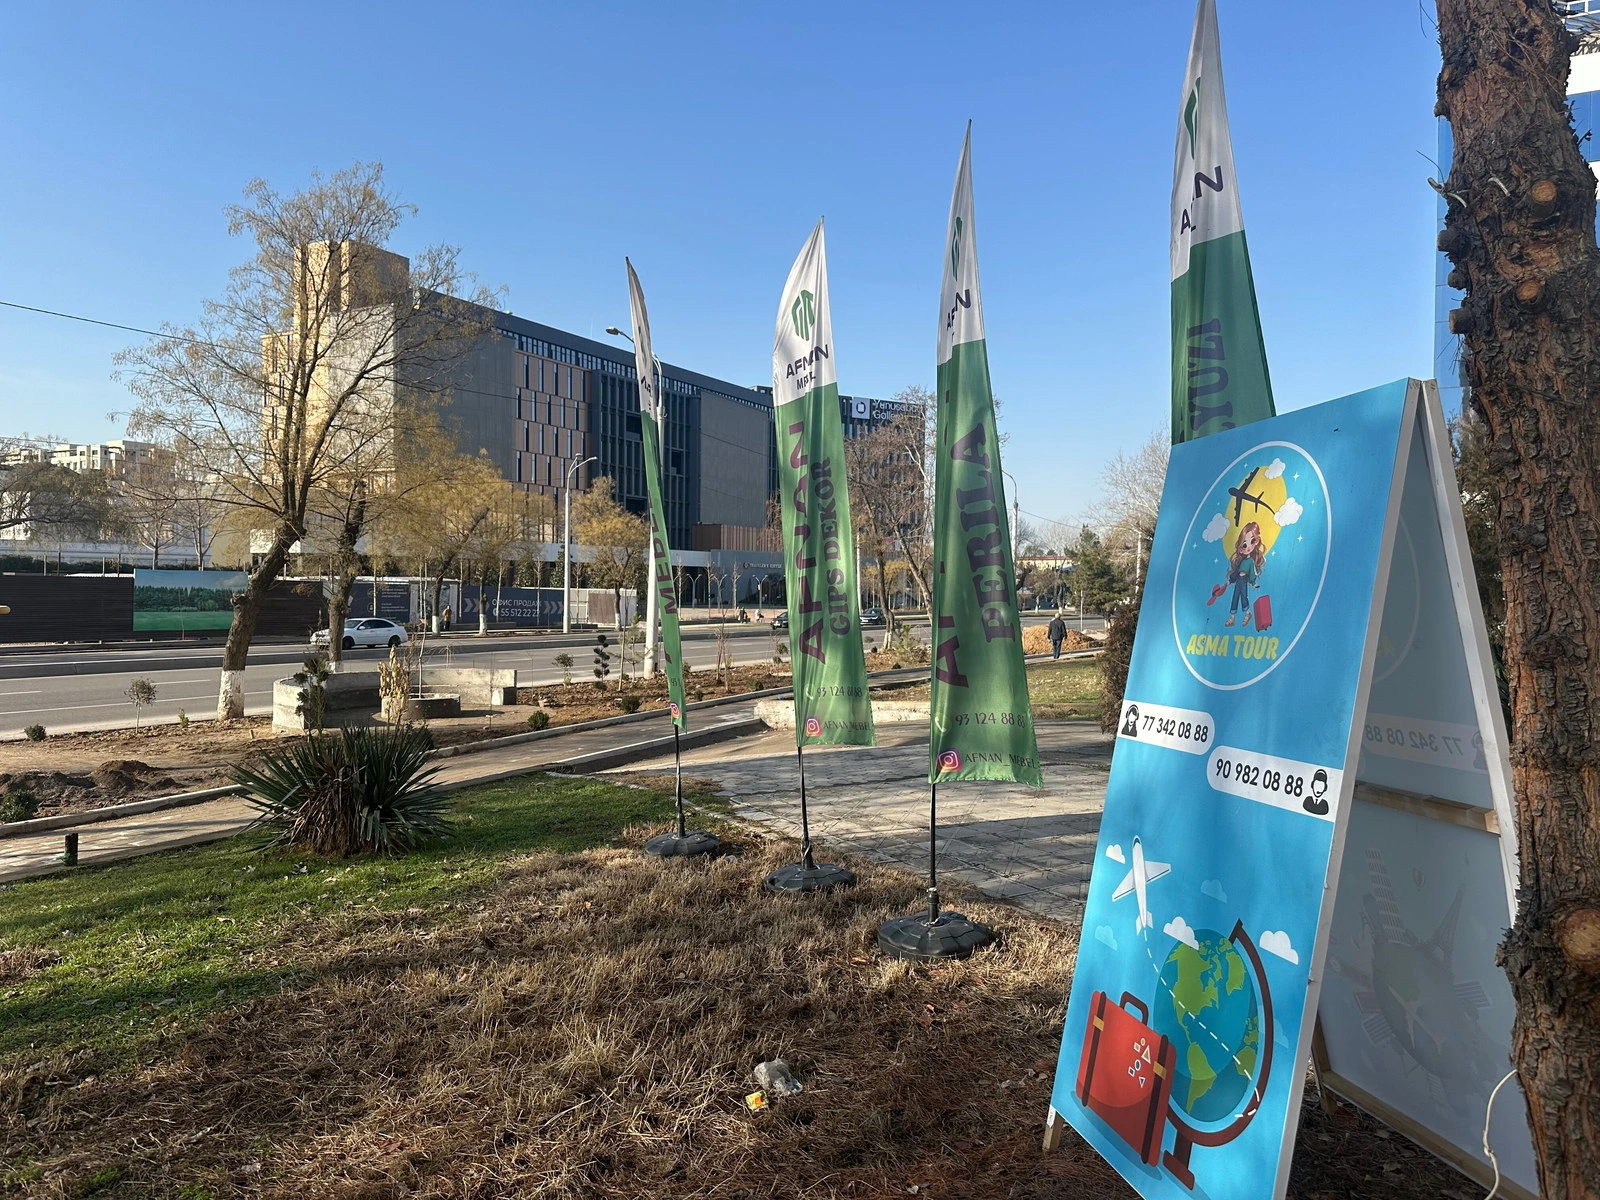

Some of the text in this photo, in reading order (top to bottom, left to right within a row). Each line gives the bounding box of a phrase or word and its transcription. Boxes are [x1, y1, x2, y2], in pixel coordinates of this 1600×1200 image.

[950, 422, 1016, 643] PERILA
[810, 456, 851, 636] GIPS DEKOR
[500, 608, 509, 617] 55
[510, 609, 521, 617] 512
[522, 609, 531, 617] 22
[1186, 634, 1279, 660] ASMA TOUR
[816, 687, 827, 698] 93
[830, 686, 845, 697] 124
[955, 714, 970, 726] 93
[974, 712, 996, 724] 124
[1001, 712, 1015, 725] 88
[1142, 715, 1209, 742] 77 342 08 88
[1215, 758, 1304, 798] 90 982 08 88
